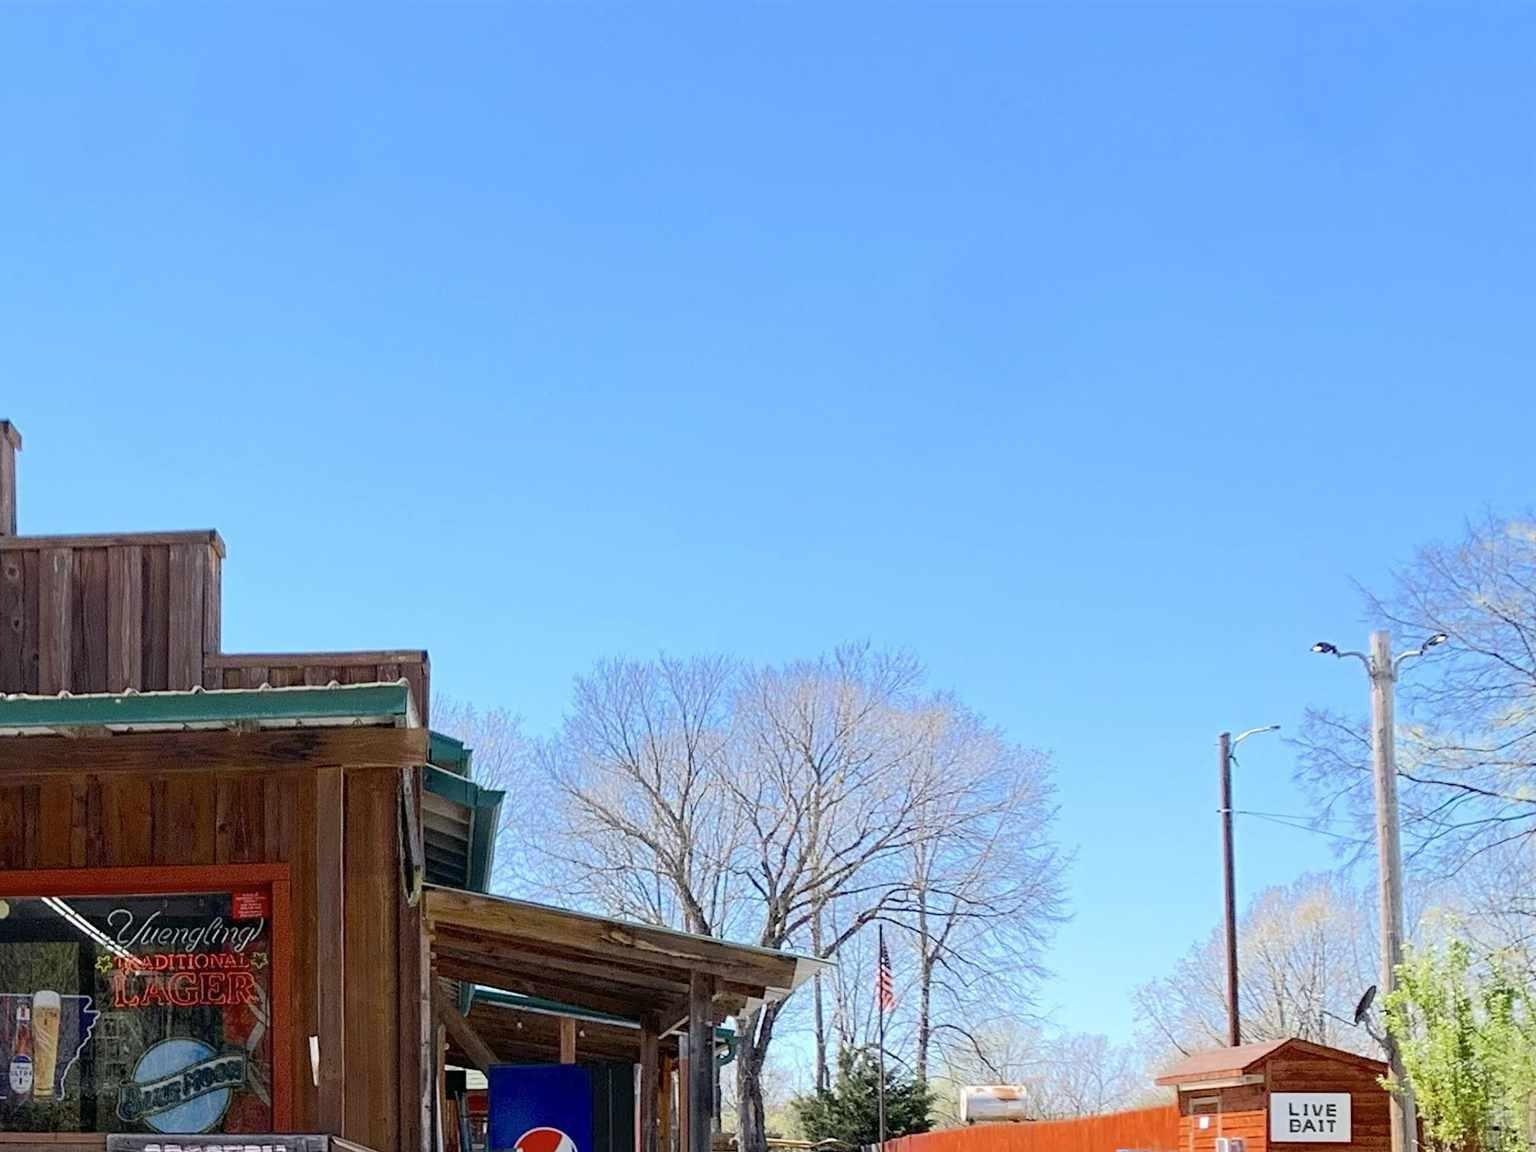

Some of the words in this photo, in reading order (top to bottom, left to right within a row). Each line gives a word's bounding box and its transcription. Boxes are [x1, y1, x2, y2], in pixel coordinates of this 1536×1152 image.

[107, 908, 264, 953] Yuengling
[115, 952, 250, 971] TRADITIONAL
[114, 971, 258, 1008] LAGER
[1288, 1102, 1337, 1117] LIVE
[1288, 1118, 1337, 1133] BAIT
